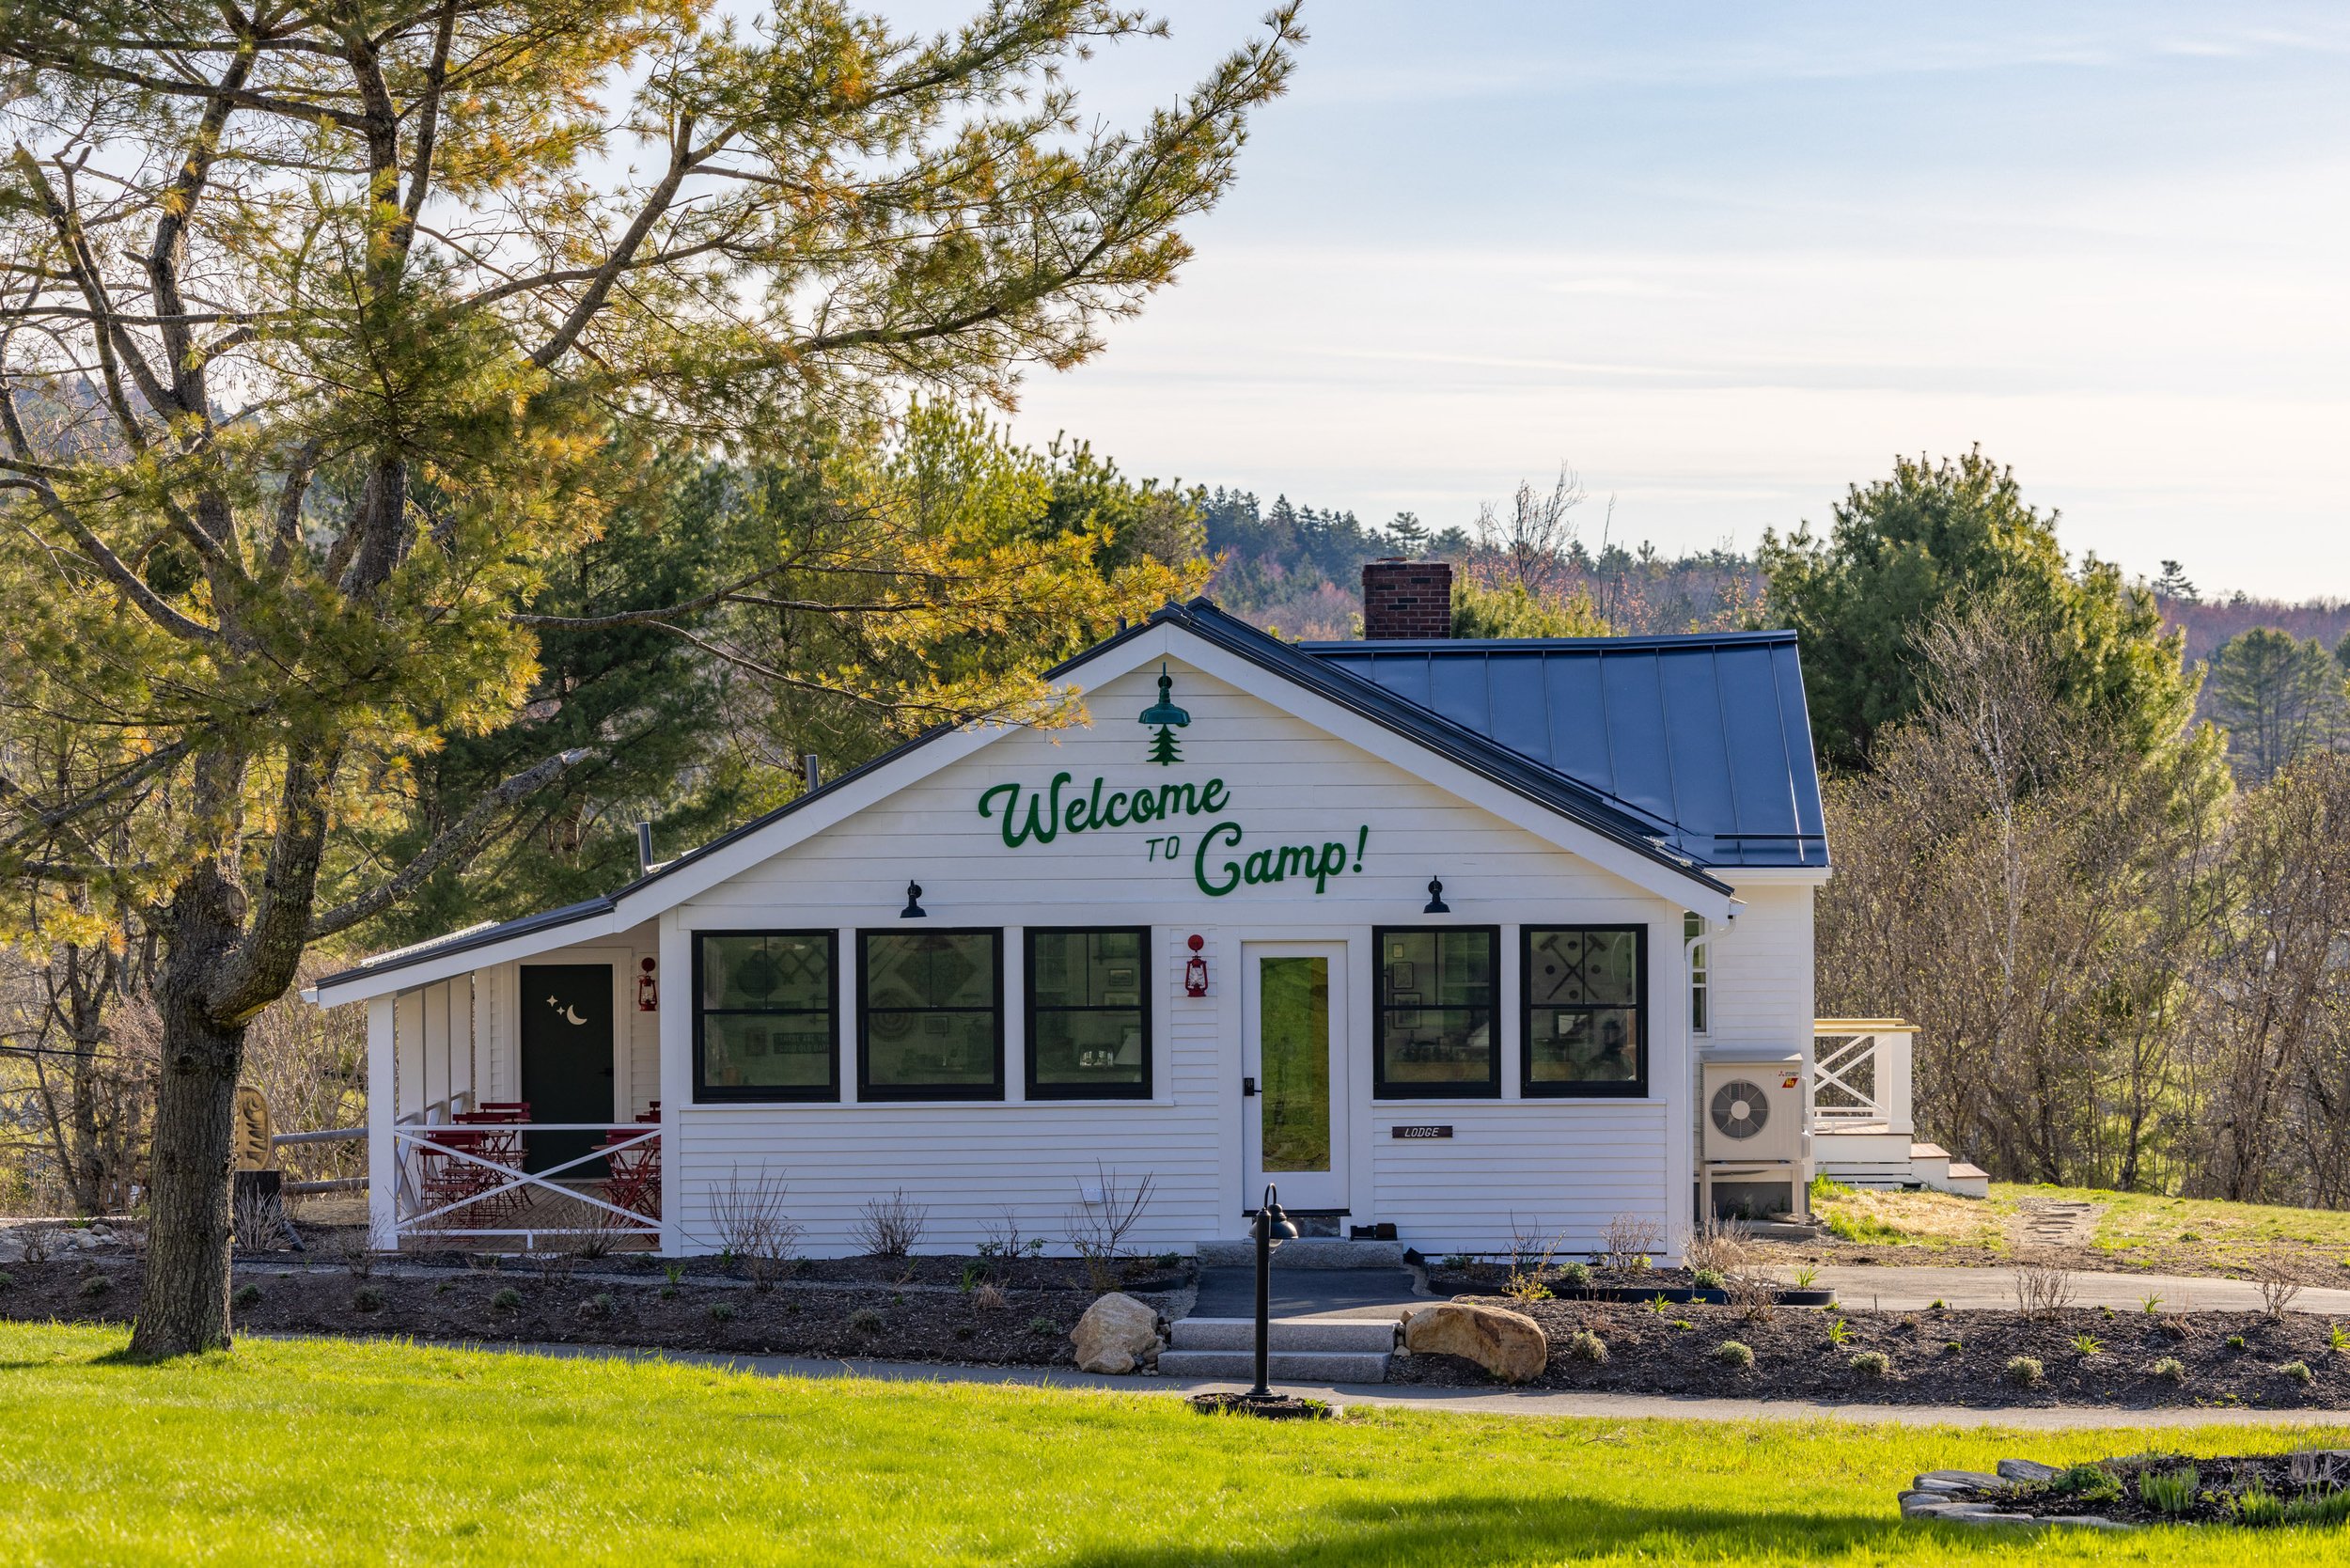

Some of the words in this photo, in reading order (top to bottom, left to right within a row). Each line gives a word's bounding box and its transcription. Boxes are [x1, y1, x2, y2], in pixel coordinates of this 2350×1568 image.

[979, 772, 1230, 848] Welcome
[1145, 835, 1180, 862] TO
[1195, 821, 1370, 897] Camp!
[1404, 1127, 1439, 1137] LODGE
